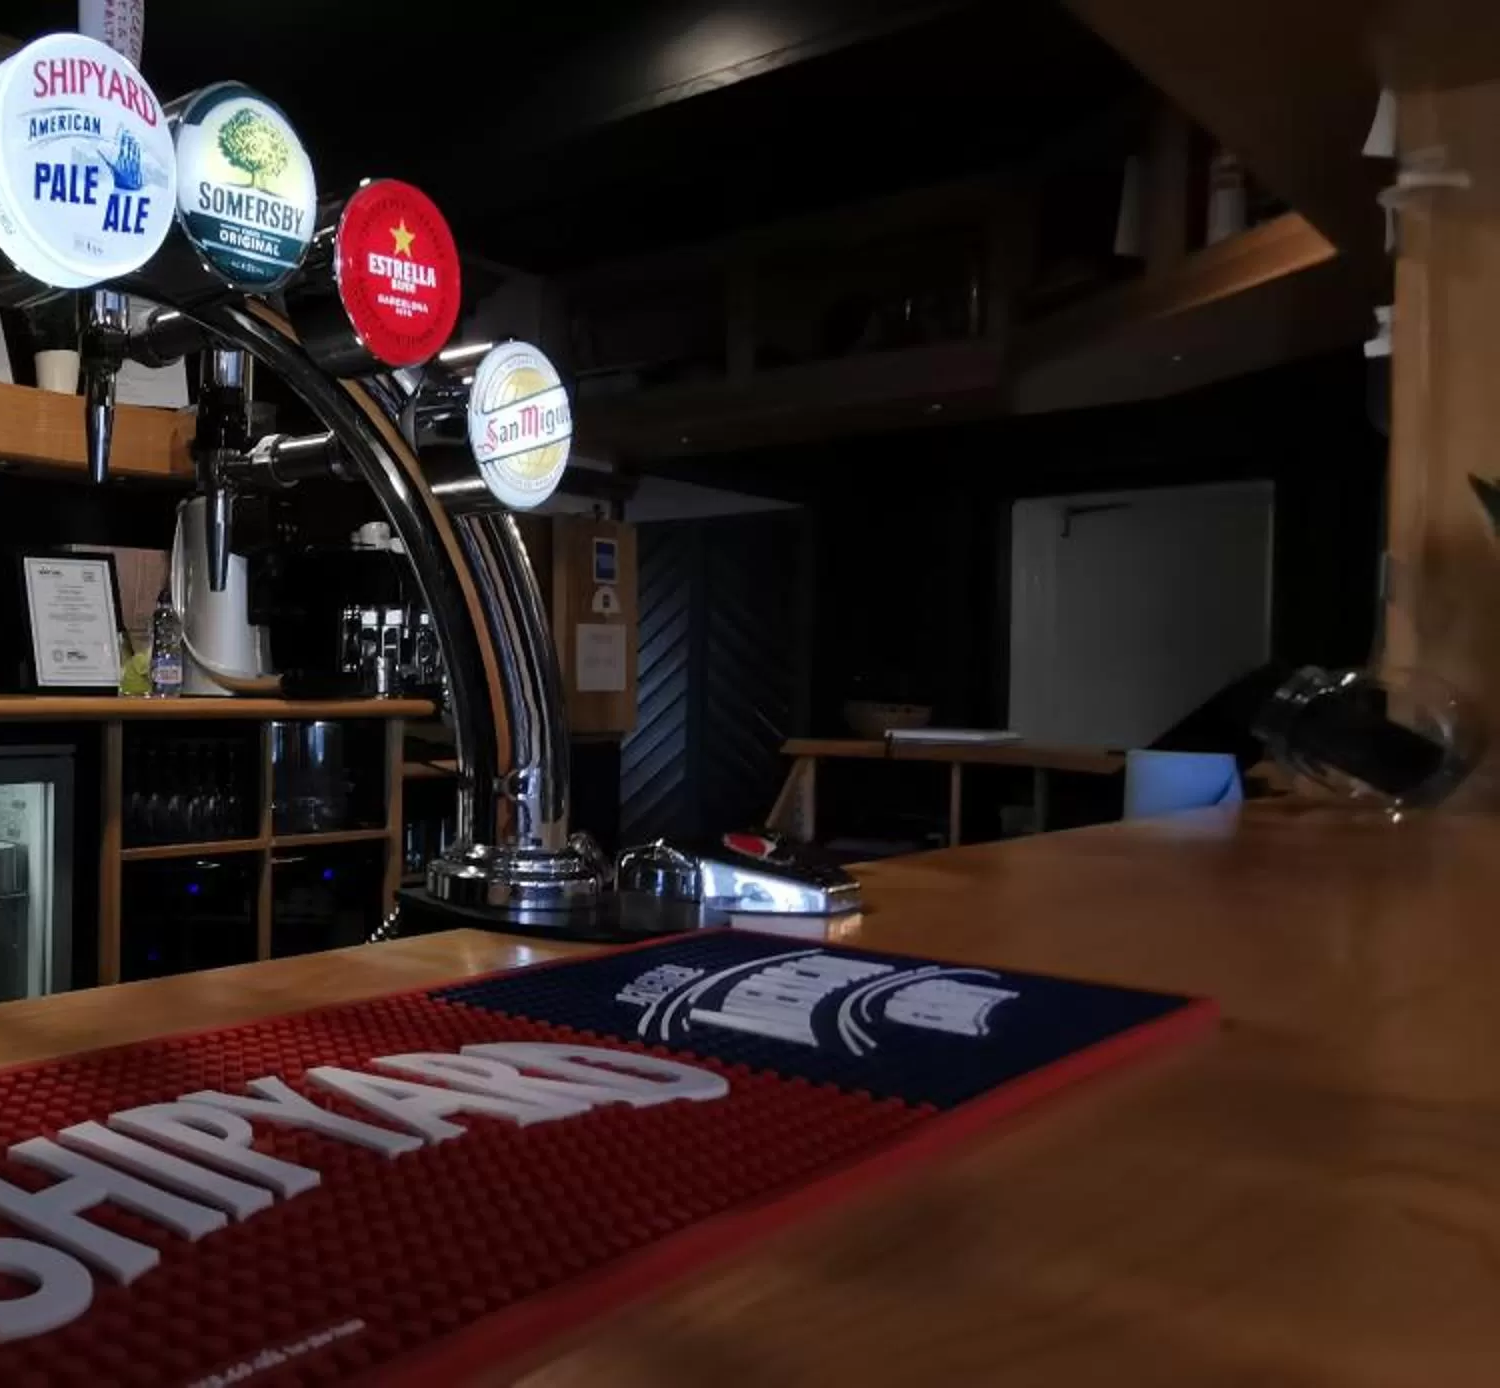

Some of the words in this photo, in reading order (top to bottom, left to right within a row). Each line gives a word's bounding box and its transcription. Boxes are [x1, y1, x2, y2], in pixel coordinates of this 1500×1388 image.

[33, 59, 158, 127] SHIPYARD
[28, 114, 100, 141] AMERICAN
[34, 162, 99, 205] PALE
[102, 193, 151, 234] ALE
[199, 181, 305, 234] SOMERSBY
[219, 229, 281, 256] ORIGINAL
[368, 252, 437, 288] ESTRELLA
[518, 404, 570, 441] Migu
